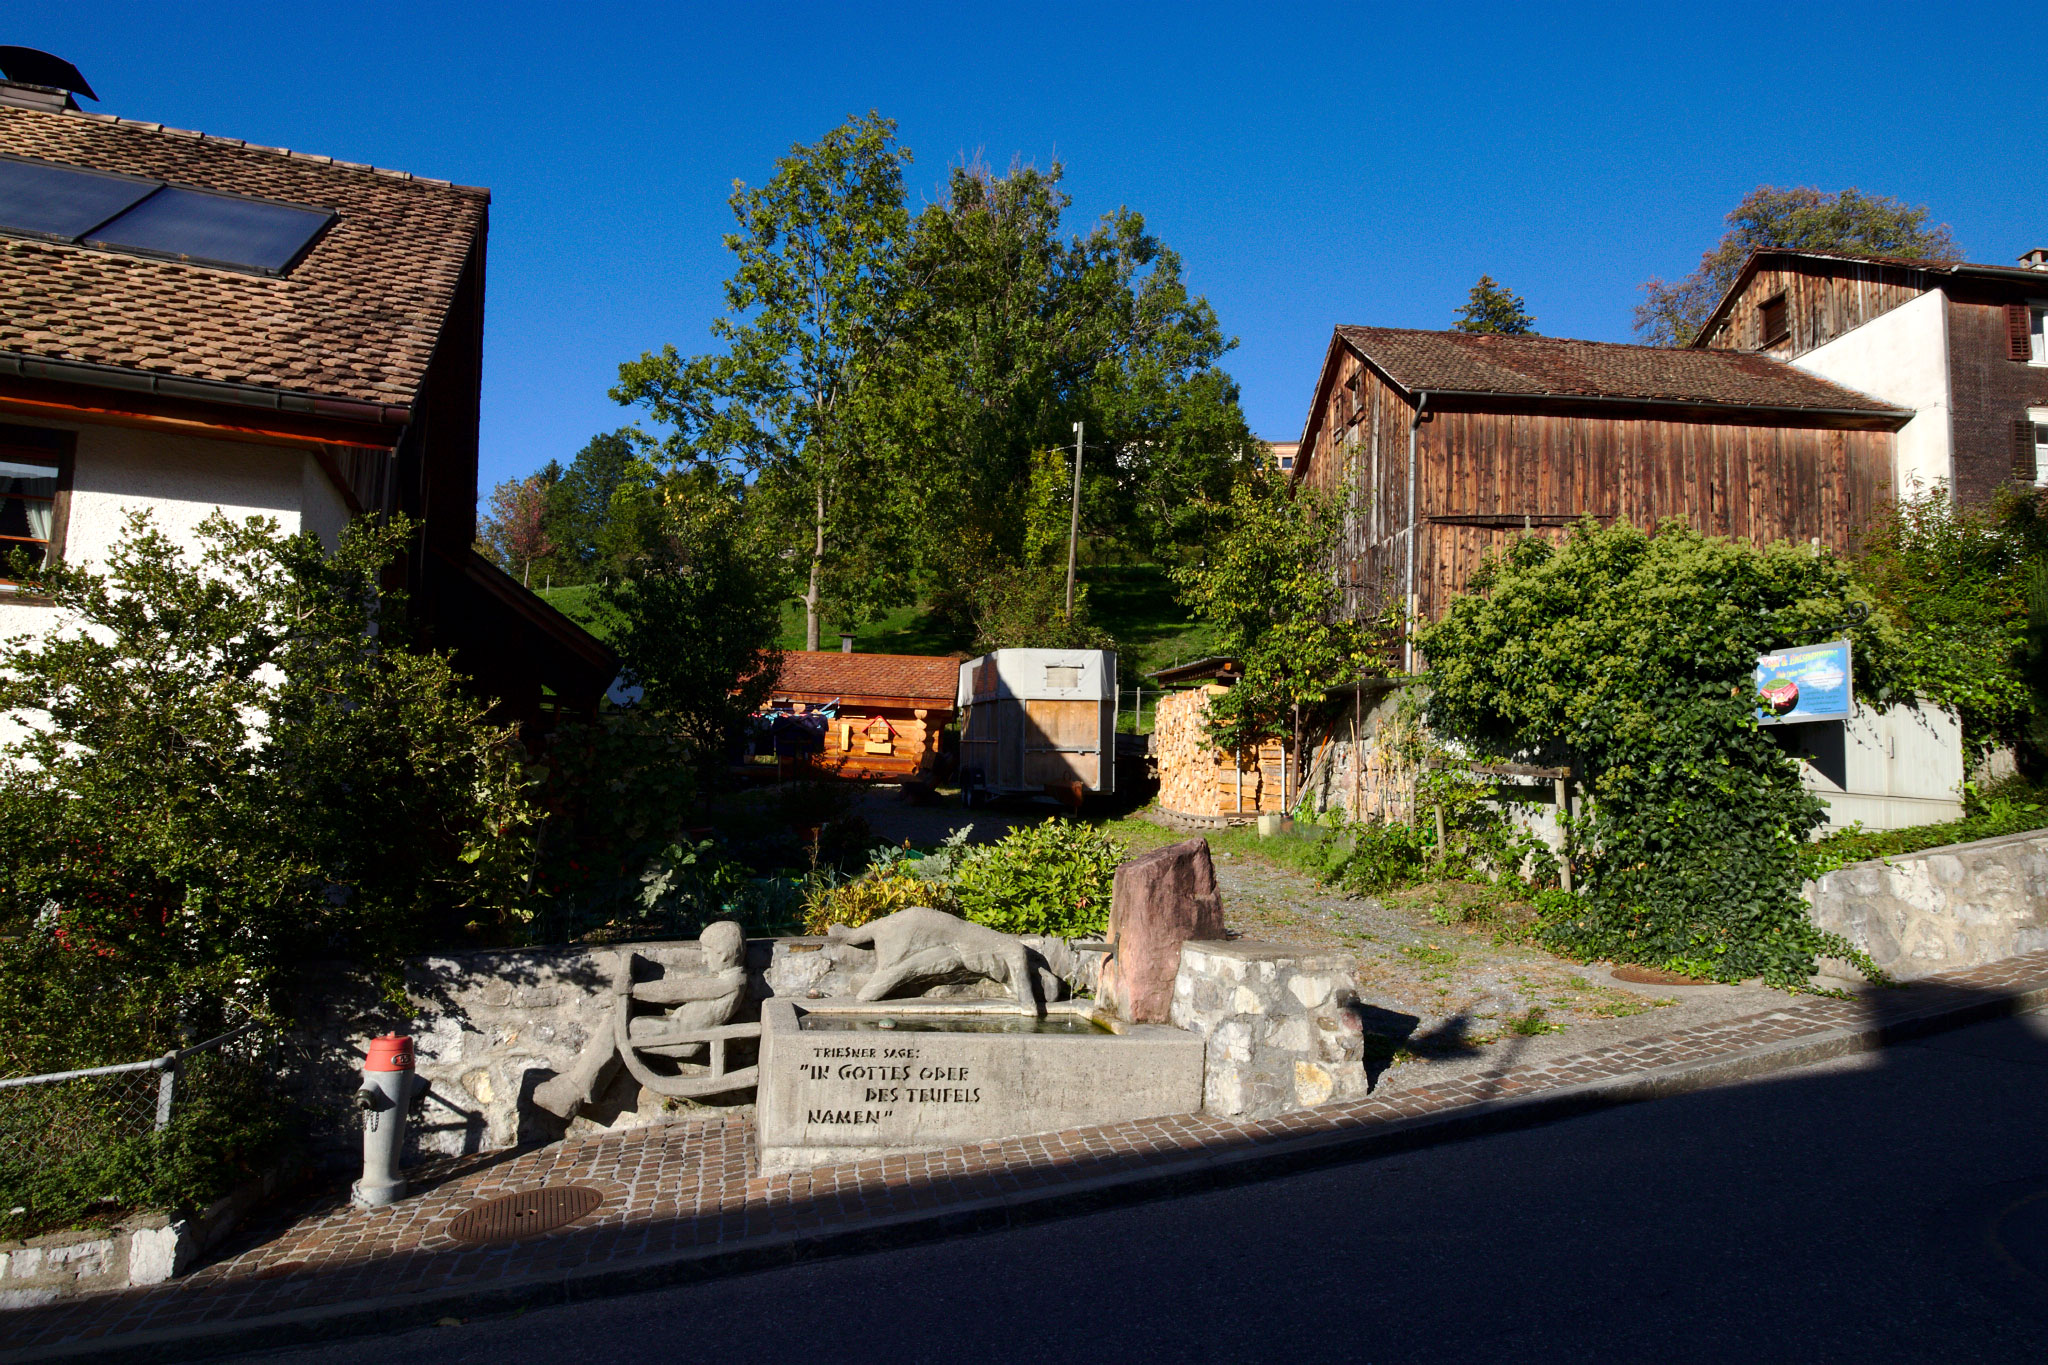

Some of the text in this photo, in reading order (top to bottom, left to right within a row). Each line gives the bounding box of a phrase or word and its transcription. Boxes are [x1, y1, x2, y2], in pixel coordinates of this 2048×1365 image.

[813, 1047, 921, 1059] TRIESNER SAGE:
[799, 1064, 970, 1081] "IN GOTTES ODER
[864, 1087, 981, 1103] DES TEUFELS
[807, 1109, 893, 1125] NAMEN"
